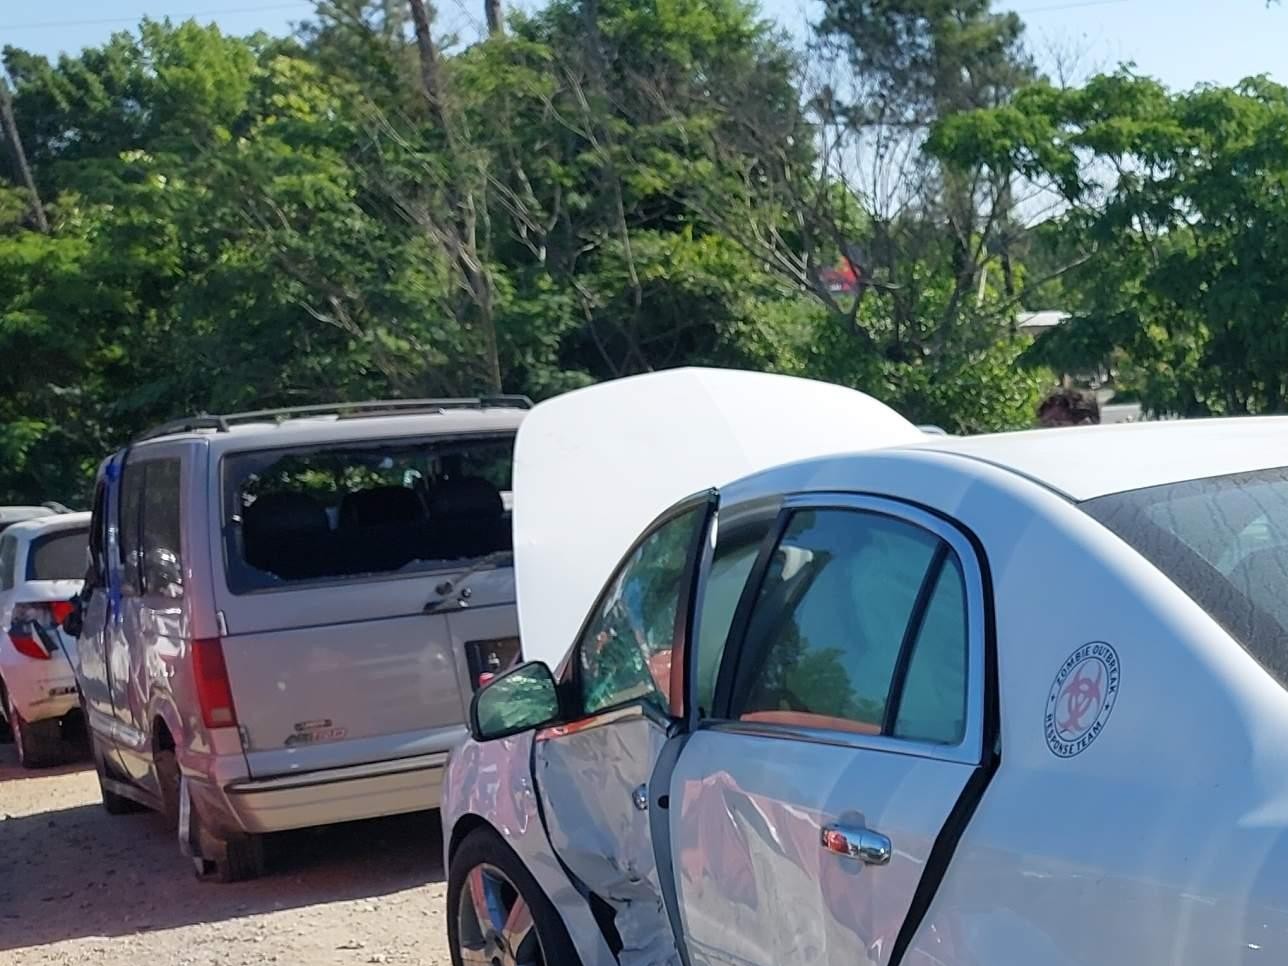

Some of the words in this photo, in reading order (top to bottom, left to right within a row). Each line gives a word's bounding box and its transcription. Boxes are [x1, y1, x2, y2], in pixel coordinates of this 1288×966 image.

[1057, 646, 1090, 687] ZOMBIE
[1092, 644, 1117, 694] OUTBREAK
[1047, 713, 1074, 755] RESPONSE
[1077, 721, 1101, 751] TEAM
